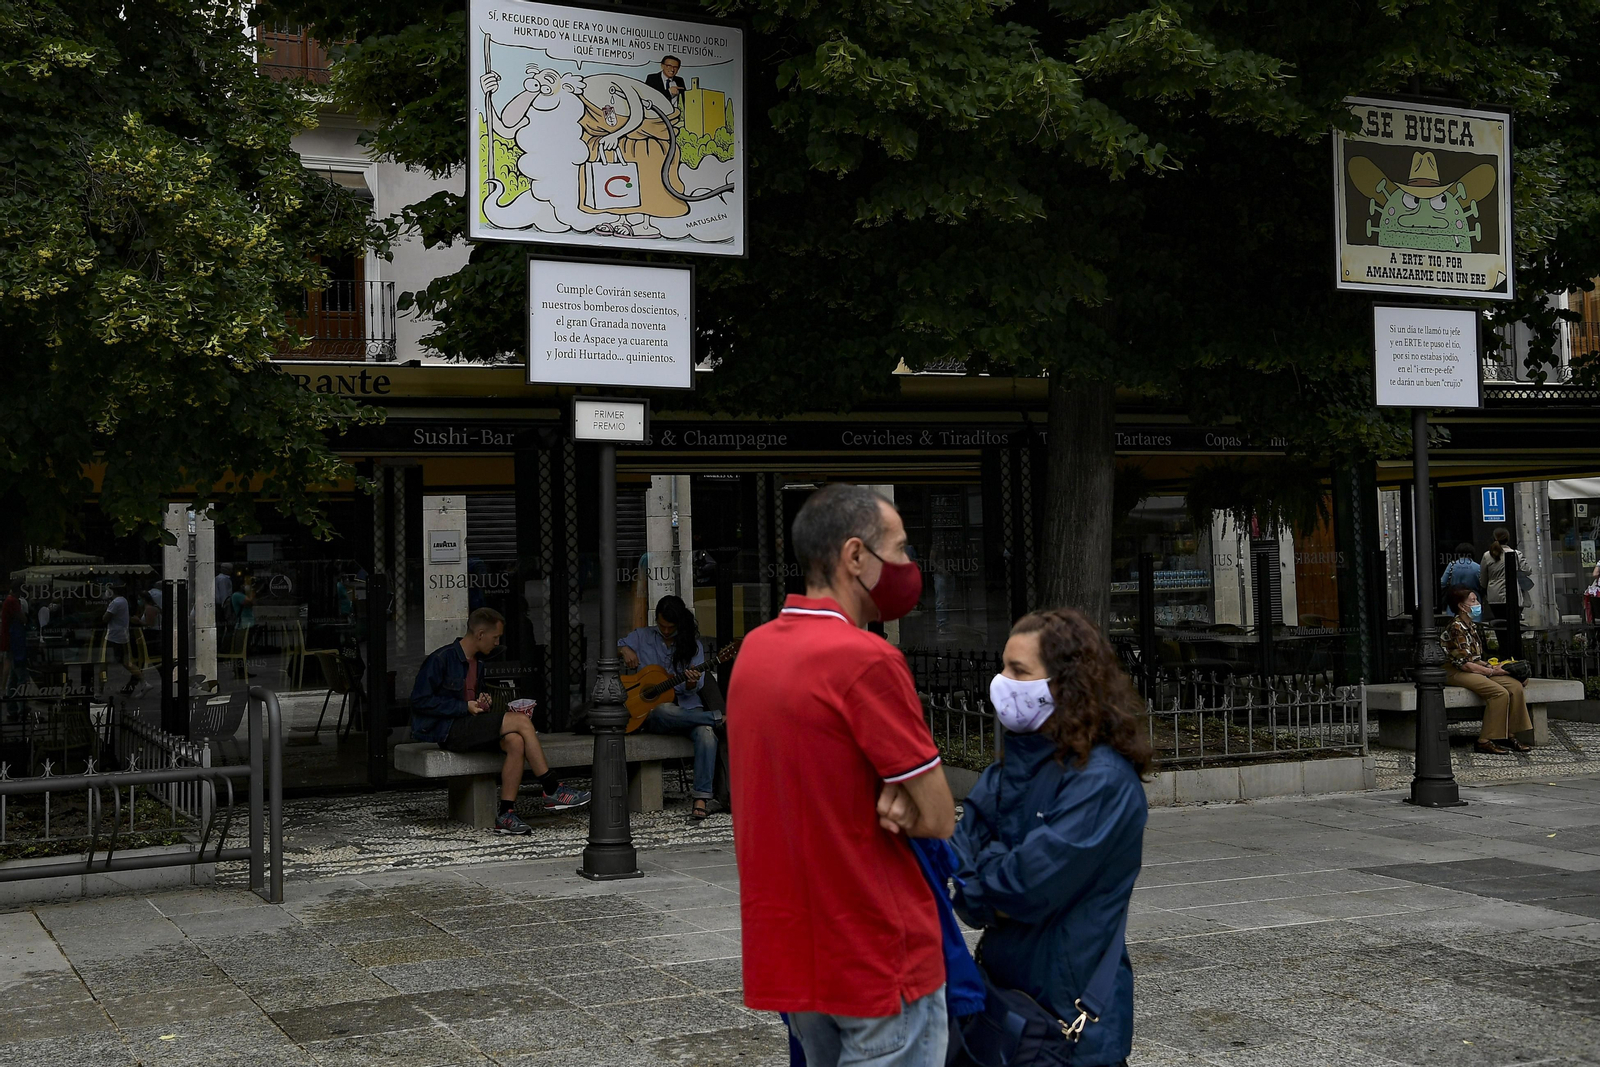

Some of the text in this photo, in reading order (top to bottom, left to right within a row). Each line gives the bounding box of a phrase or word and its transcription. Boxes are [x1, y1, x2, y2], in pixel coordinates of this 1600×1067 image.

[488, 9, 728, 47] SÍ, RECUERDO QUE ERA YO UN CHIQUILLO CUANDO JORDI
[513, 27, 722, 58] HURTADO YA LLEVABA MIL AÑOS EN TELEVISIÓN...
[573, 45, 635, 60] ¡QUÉ TIEMPOS!
[1366, 110, 1474, 146] SE BUSCA
[685, 213, 728, 228] MATUSALÉN
[1390, 253, 1397, 263] A
[1446, 257, 1462, 268] POR
[1366, 266, 1486, 285] AMANAZARME CON UN ERE
[556, 283, 666, 299] Cumple Covirán sesenta
[542, 301, 680, 317] nuestros bomberos doscientos,
[556, 316, 666, 331] el gran Granada noventa
[1390, 324, 1396, 333] Si
[1425, 325, 1441, 335] llamó
[1450, 326, 1461, 337] jefe
[554, 332, 669, 347] los de Aspace ya cuarenta
[1390, 340, 1394, 349] y
[1404, 338, 1422, 347] ERTE
[1430, 341, 1444, 350] puso
[1445, 339, 1451, 348] el
[546, 349, 677, 365] y Jordi Hurtado... quinientos.
[1393, 353, 1403, 362] por
[1405, 351, 1410, 360] si
[1420, 352, 1442, 361] estabas
[1407, 364, 1413, 373] el
[1426, 378, 1441, 387] buen
[594, 410, 625, 420] PRIMER
[593, 421, 626, 431] PREMIO
[413, 427, 515, 445] Sushi-Bar
[661, 430, 678, 446] &
[684, 430, 788, 451] Champagne
[841, 430, 1009, 446] Ceviches & Tiraditos
[1114, 432, 1172, 446] Tartares
[1205, 432, 1242, 451] Copas
[1487, 490, 1499, 507] H
